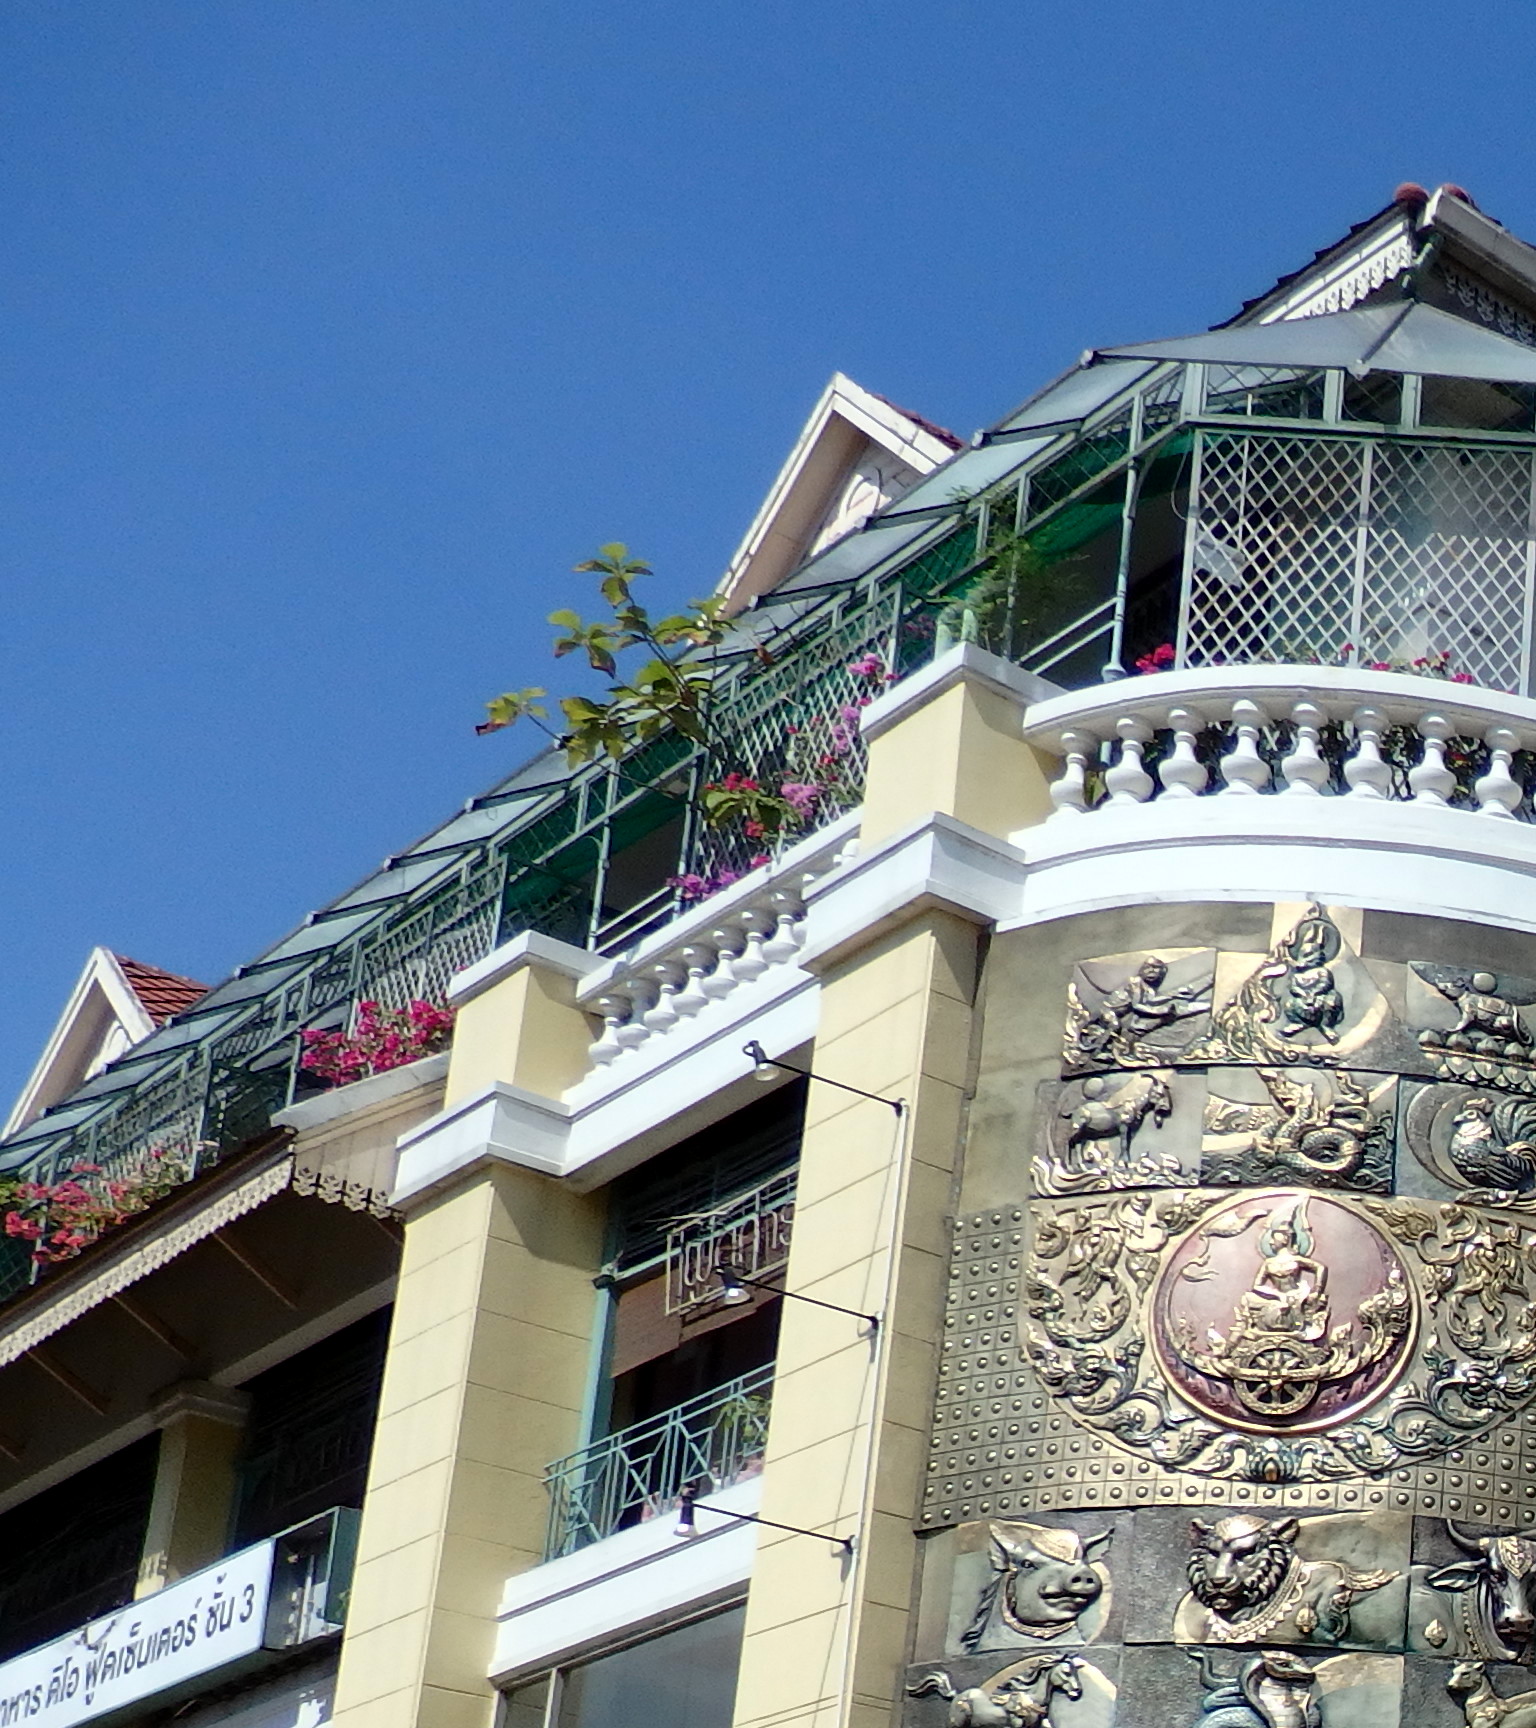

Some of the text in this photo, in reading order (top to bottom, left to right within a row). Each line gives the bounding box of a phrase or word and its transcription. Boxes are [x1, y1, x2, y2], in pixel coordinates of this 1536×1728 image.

[45, 1656, 80, 1709] ดิโอ
[206, 1572, 236, 1638] ชั้น
[240, 1583, 255, 1624] 3
